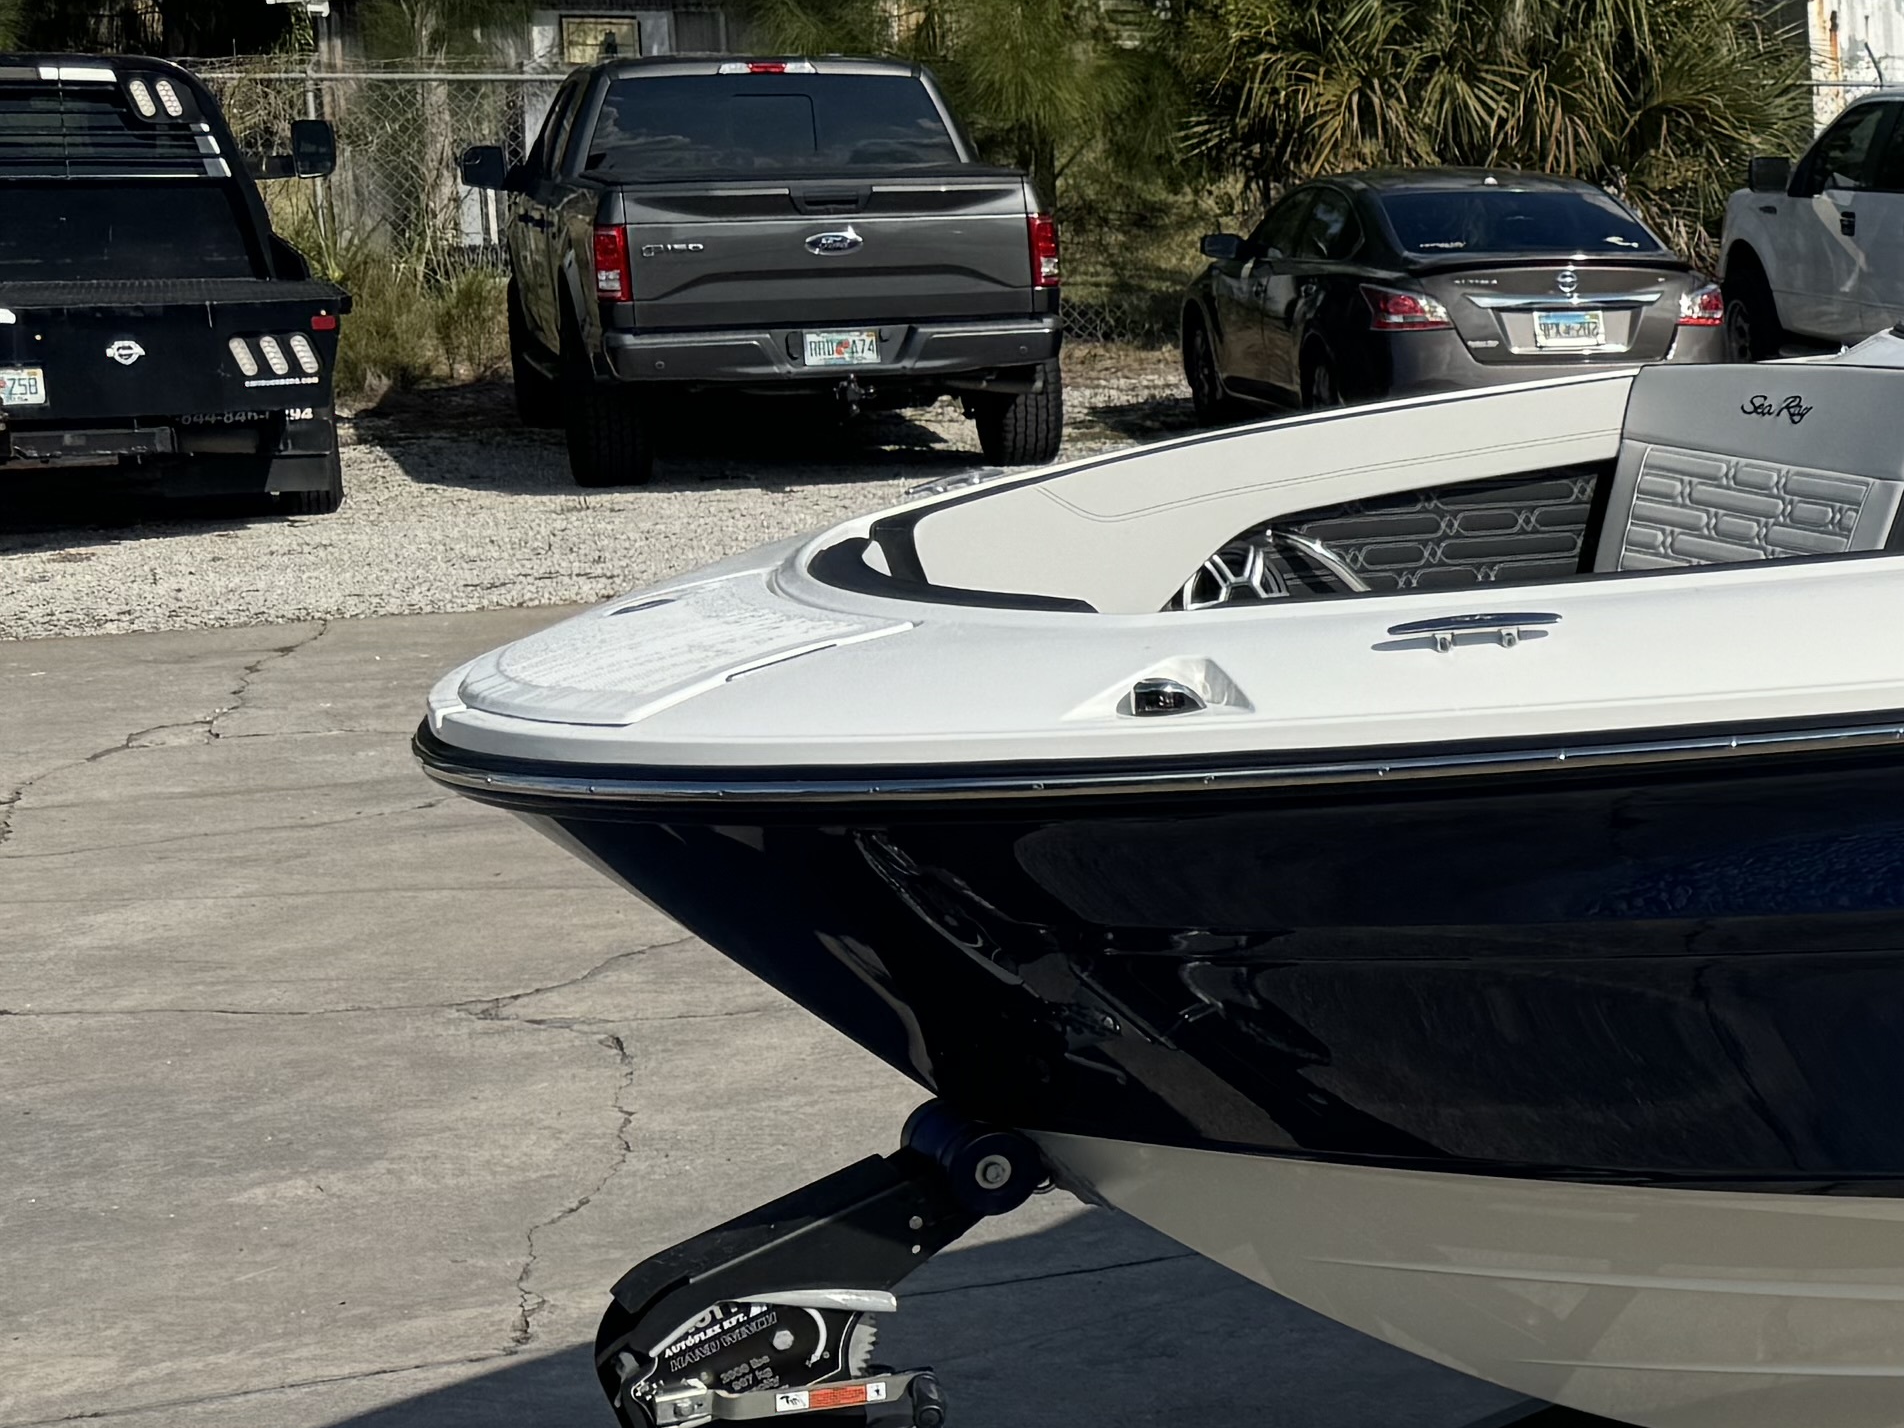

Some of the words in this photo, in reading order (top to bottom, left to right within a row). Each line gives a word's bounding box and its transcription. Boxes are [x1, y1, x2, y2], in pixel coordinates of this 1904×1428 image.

[1740, 394, 1775, 417] Sea
[1775, 394, 1813, 424] Ray
[669, 1341, 722, 1372] HAND
[719, 1311, 778, 1347] WINCH
